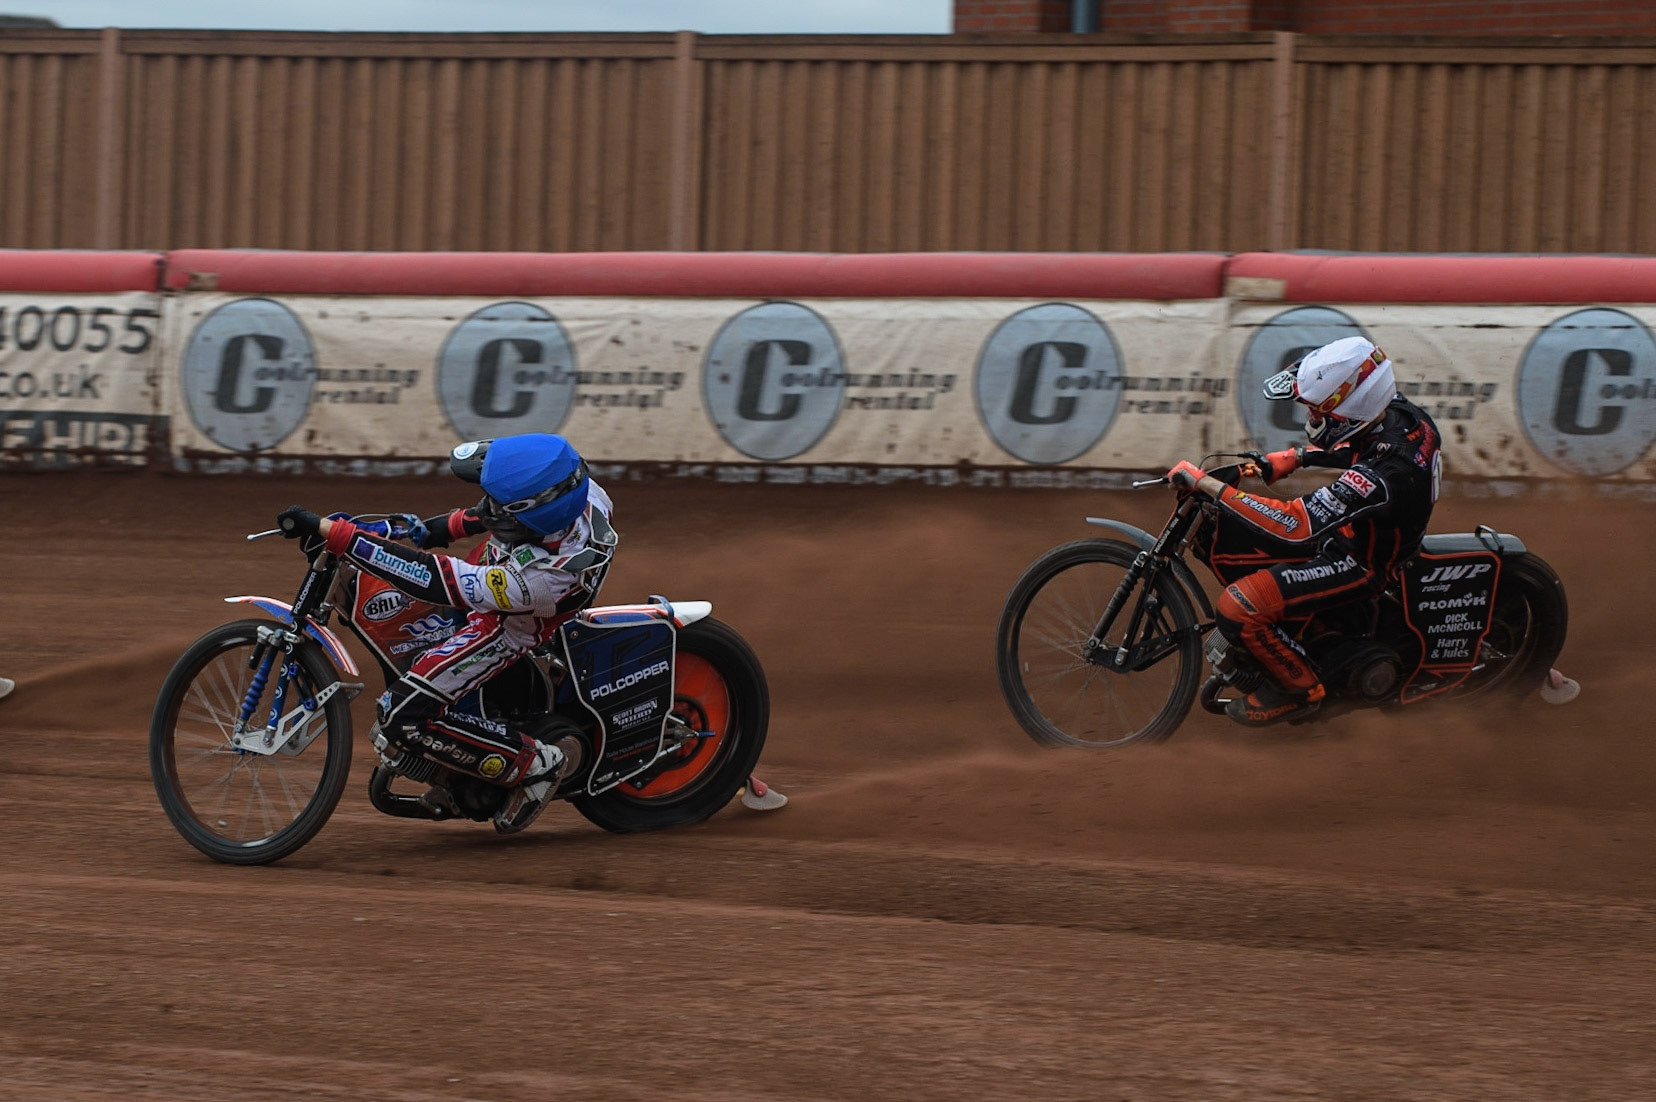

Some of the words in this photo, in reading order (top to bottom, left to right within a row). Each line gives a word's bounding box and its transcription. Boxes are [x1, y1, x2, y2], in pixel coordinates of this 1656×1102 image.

[1343, 471, 1373, 494] NGK
[1306, 502, 1330, 523] SKIPS
[374, 547, 432, 583] burnside
[1420, 564, 1492, 583] JWP
[293, 572, 317, 614] POLCOPPER
[1421, 583, 1452, 592] racing
[1427, 621, 1484, 634] MCNICOLL
[1445, 612, 1469, 624] DICK
[1431, 649, 1440, 659] &
[1442, 647, 1470, 659] Jules
[1436, 638, 1469, 649] Harry
[590, 660, 671, 701] POLCOPPER
